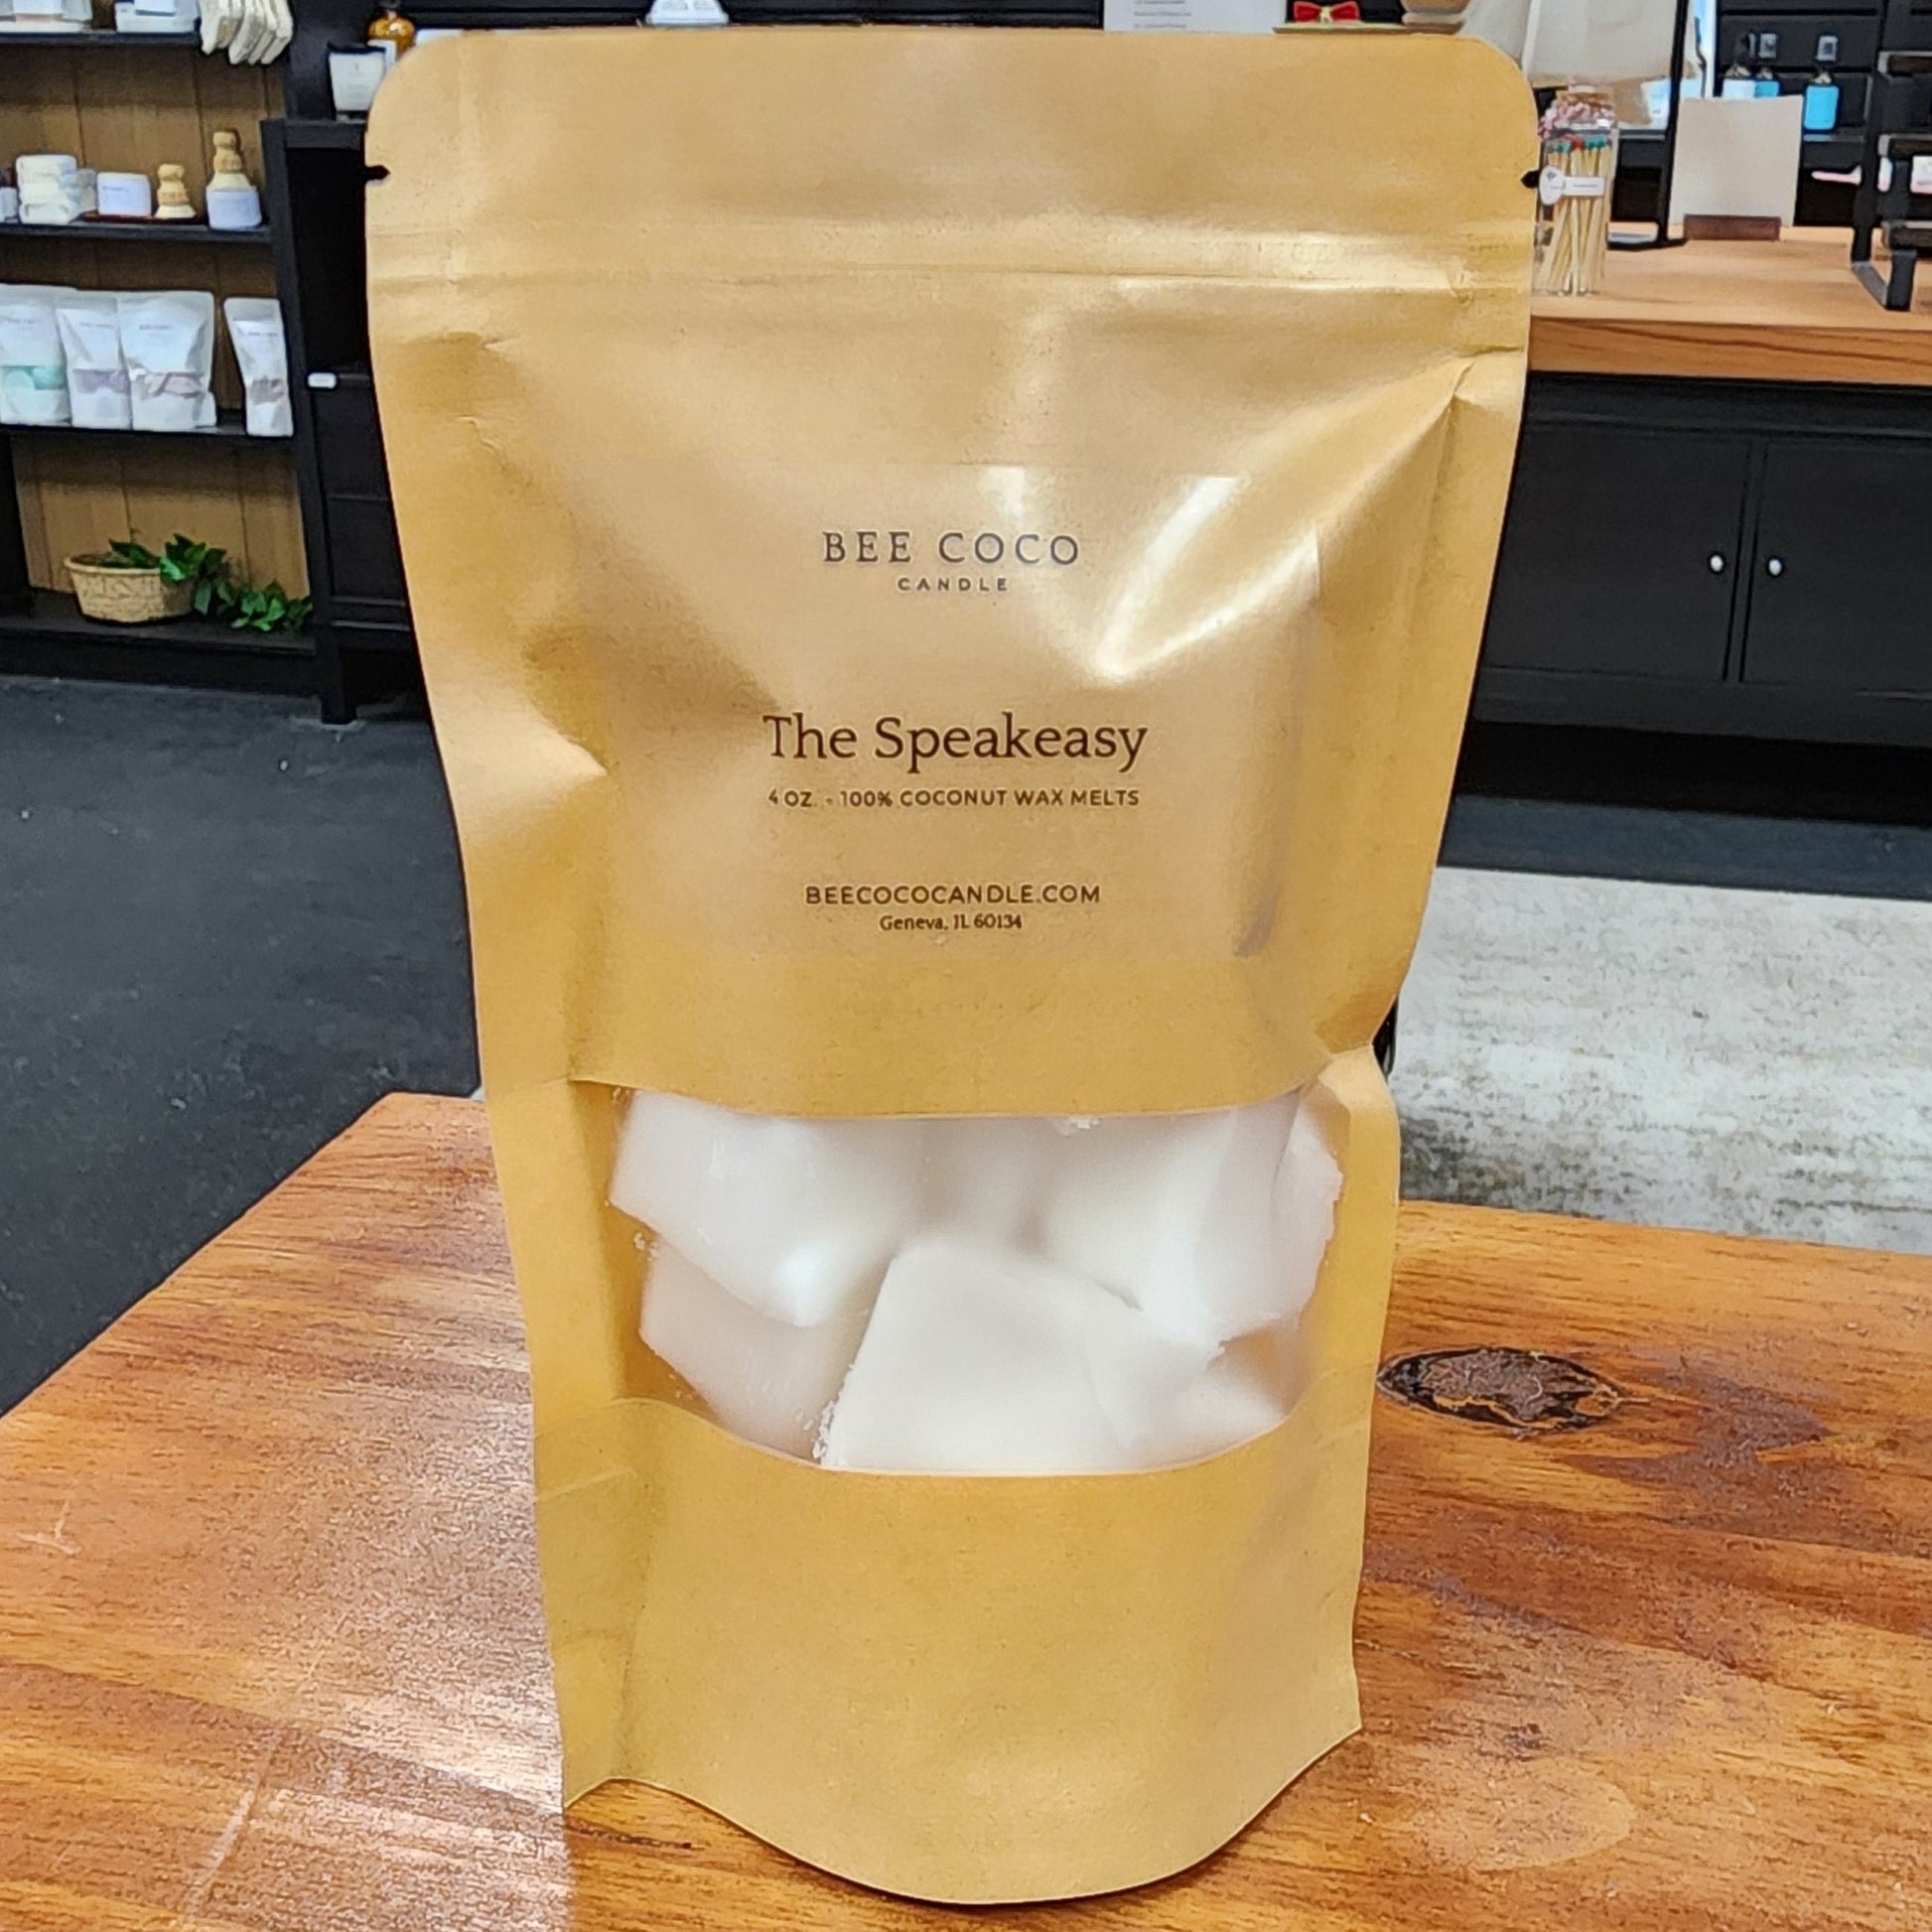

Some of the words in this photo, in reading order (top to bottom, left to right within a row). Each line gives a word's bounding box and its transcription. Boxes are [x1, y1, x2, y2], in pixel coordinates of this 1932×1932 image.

[822, 531, 911, 563] BEE
[938, 532, 1079, 565] COCO
[897, 577, 1008, 592] CANDLE
[762, 712, 858, 759] The
[874, 712, 1149, 773] Speakeasy
[767, 788, 779, 806] 4
[841, 790, 894, 807] 100%
[899, 789, 1008, 807] COCONUT
[1014, 788, 1064, 806] WAX
[1070, 789, 1140, 806] MELTS
[805, 884, 1100, 904] BEECOCOCANDLE.COM
[879, 914, 949, 931] Geneva,
[952, 914, 971, 930] IL
[974, 913, 1023, 930] 60134
